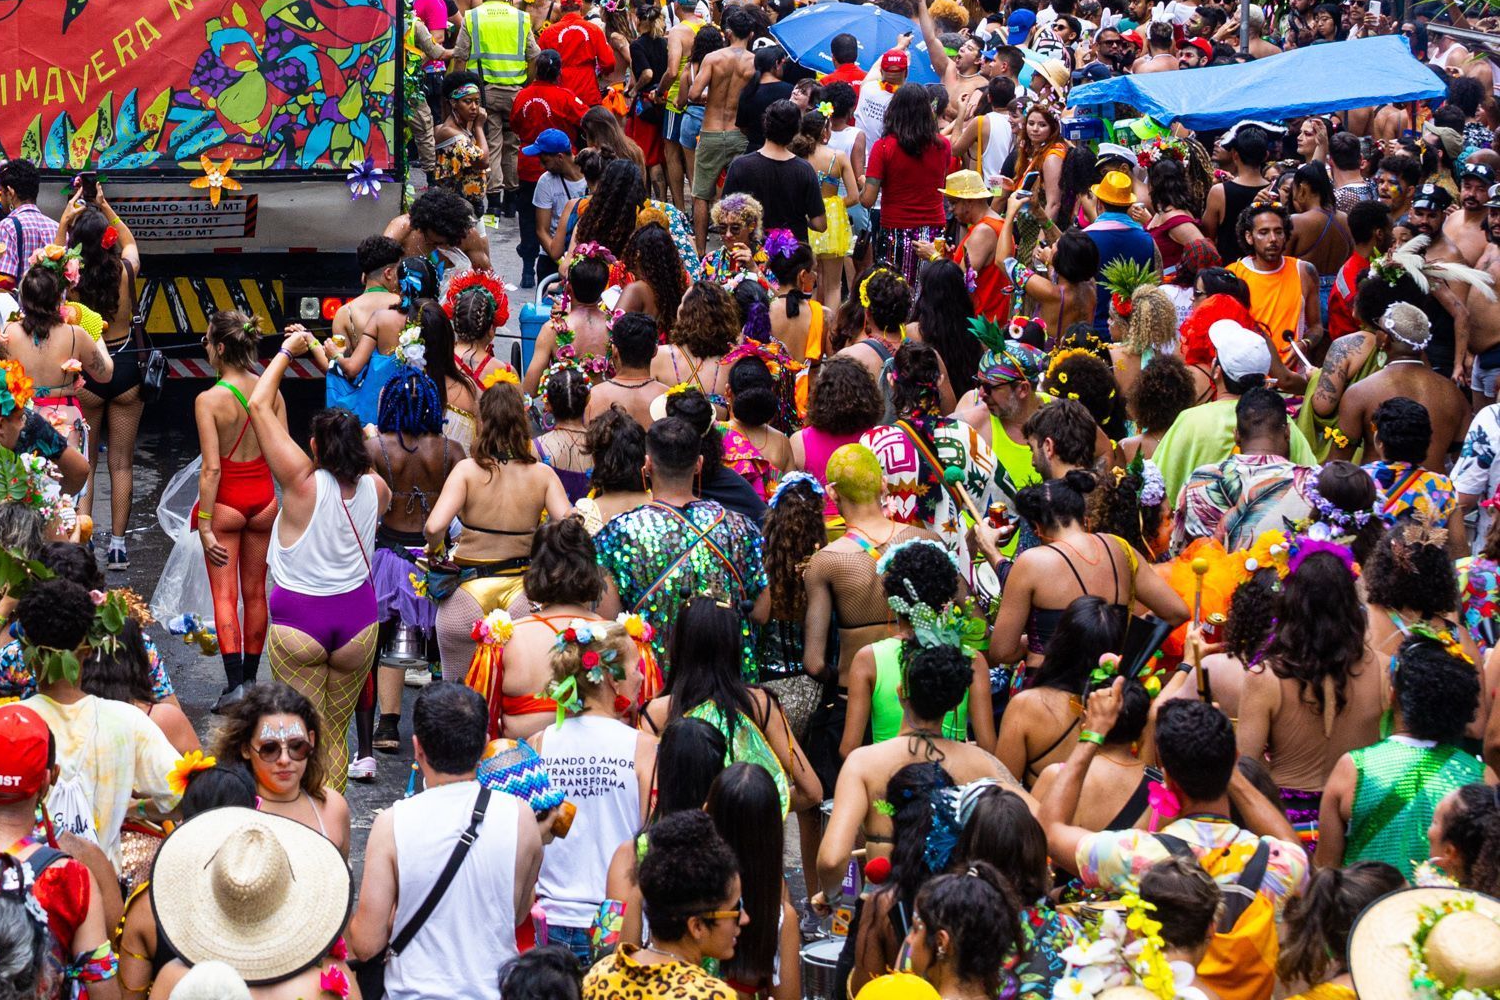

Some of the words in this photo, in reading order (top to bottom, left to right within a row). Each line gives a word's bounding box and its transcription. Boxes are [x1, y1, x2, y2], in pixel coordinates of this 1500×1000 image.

[223, 202, 241, 211] MT
[173, 217, 198, 225] 2.50
[203, 216, 220, 224] MT
[589, 756, 596, 765] O
[599, 756, 635, 770] AMOR
[546, 766, 618, 777] TRANSBORDA
[552, 777, 626, 790] TRANSFORMA
